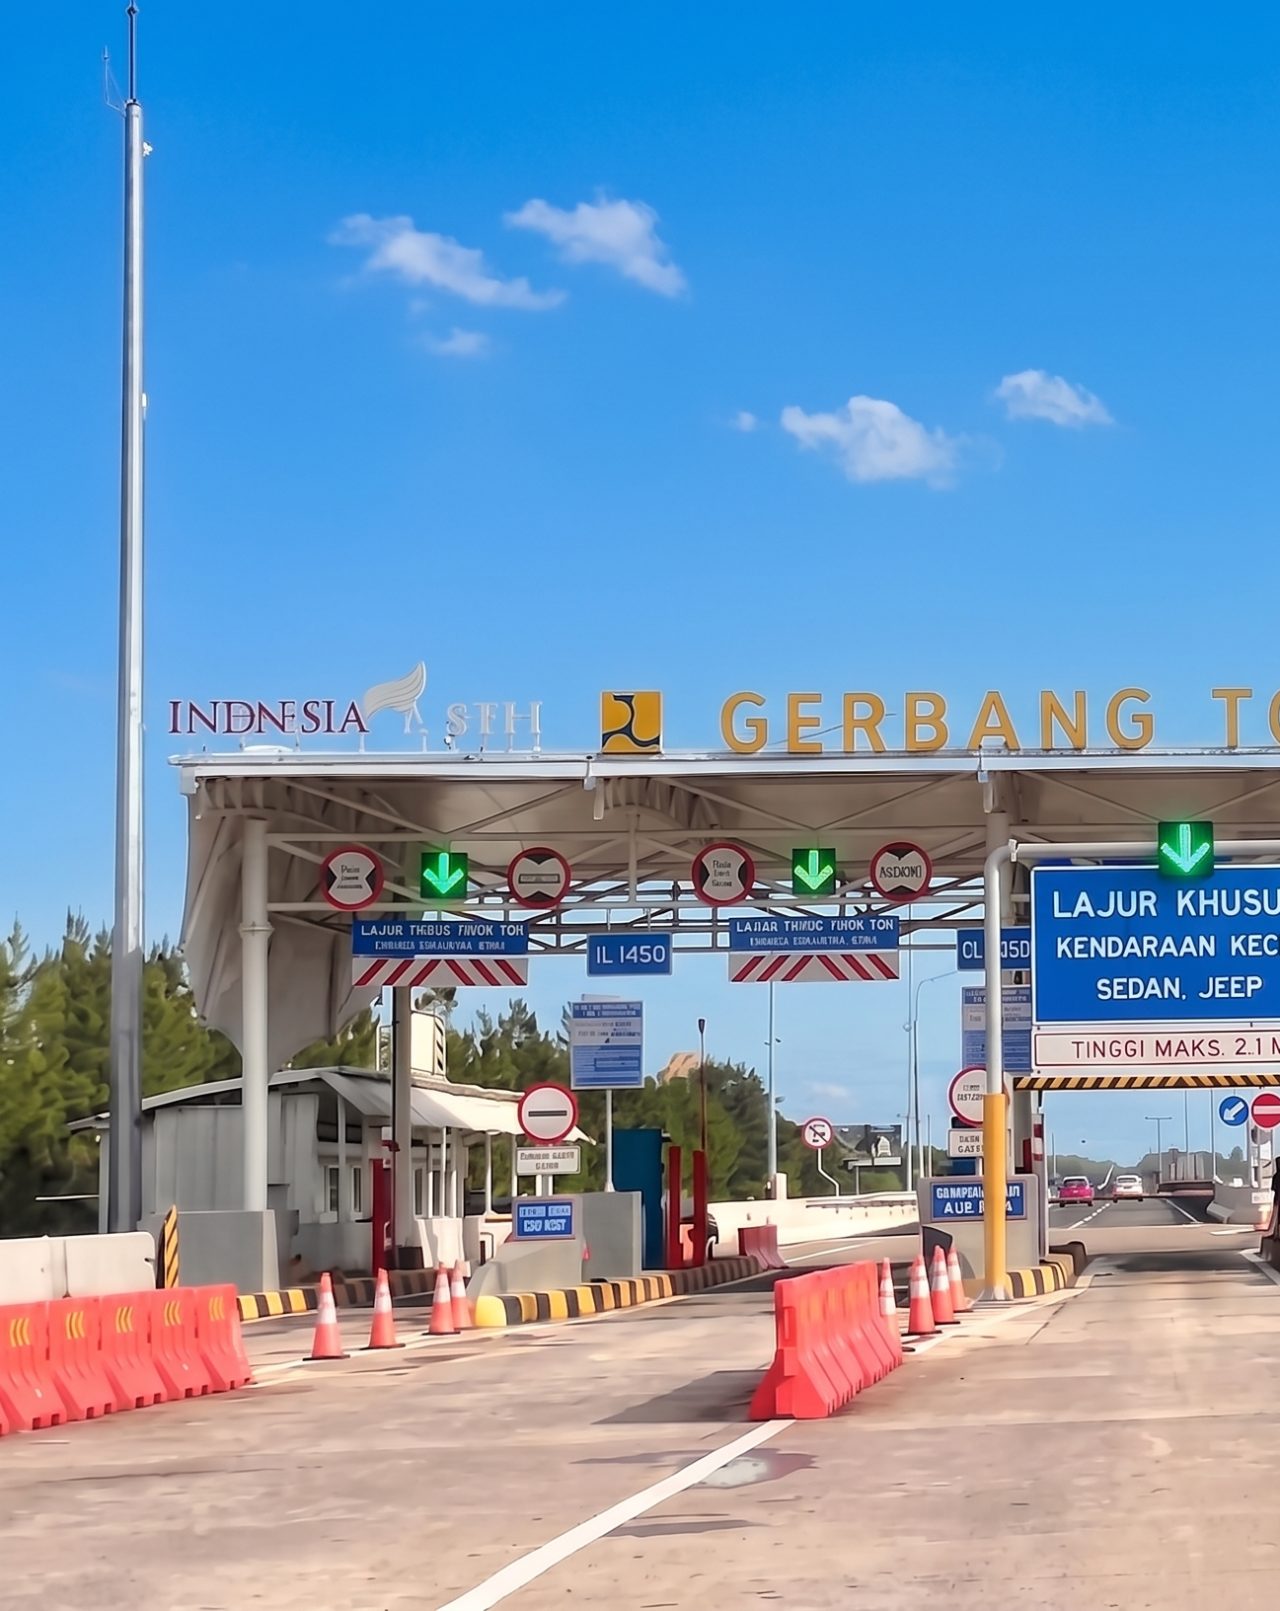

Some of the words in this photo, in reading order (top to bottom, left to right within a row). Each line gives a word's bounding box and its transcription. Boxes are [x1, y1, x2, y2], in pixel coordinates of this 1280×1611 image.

[720, 688, 1155, 754] GERBANG
[1053, 889, 1158, 918] LAJUR
[361, 924, 404, 937] LAJUR
[869, 918, 894, 931] TON
[620, 944, 666, 964] 1450
[1056, 935, 1216, 959] KENDARAAN
[1198, 975, 1263, 999] JEEP
[1072, 1039, 1145, 1059] TINGGI
[1155, 1037, 1225, 1058] MAKS.
